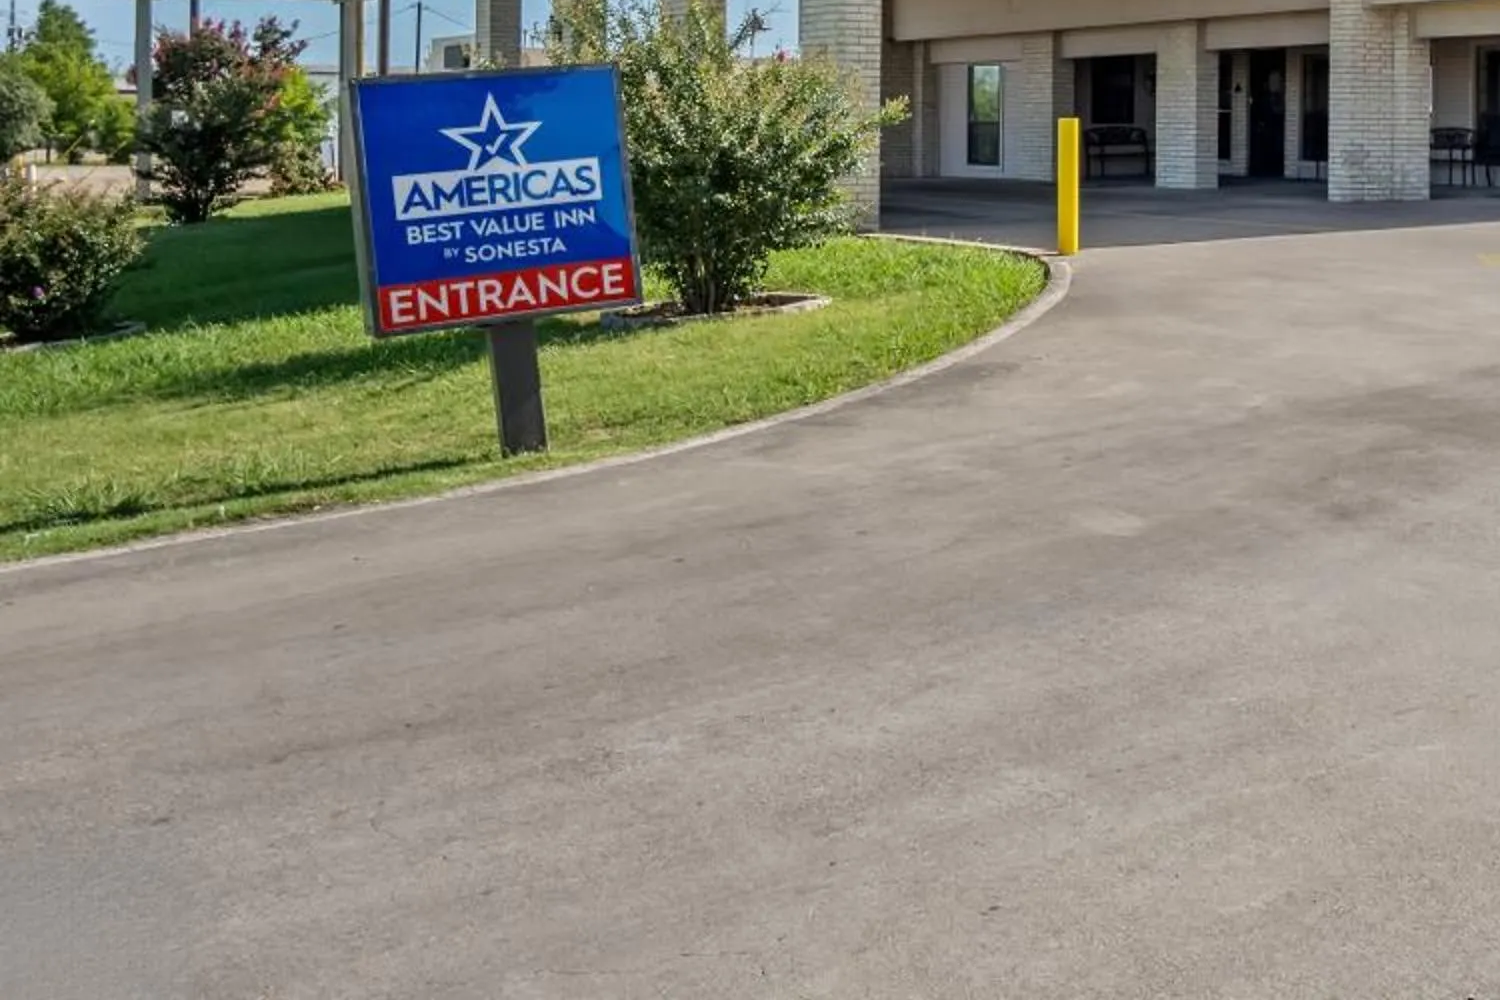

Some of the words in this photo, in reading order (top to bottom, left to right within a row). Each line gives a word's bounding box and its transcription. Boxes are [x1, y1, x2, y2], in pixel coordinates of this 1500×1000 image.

[402, 165, 597, 214] AMERICAS
[406, 221, 464, 245] BEST
[469, 212, 545, 237] VALUE
[554, 206, 596, 229] INN
[444, 247, 459, 259] BY
[465, 237, 567, 263] SONESTA
[388, 263, 626, 324] ENTRANCE
